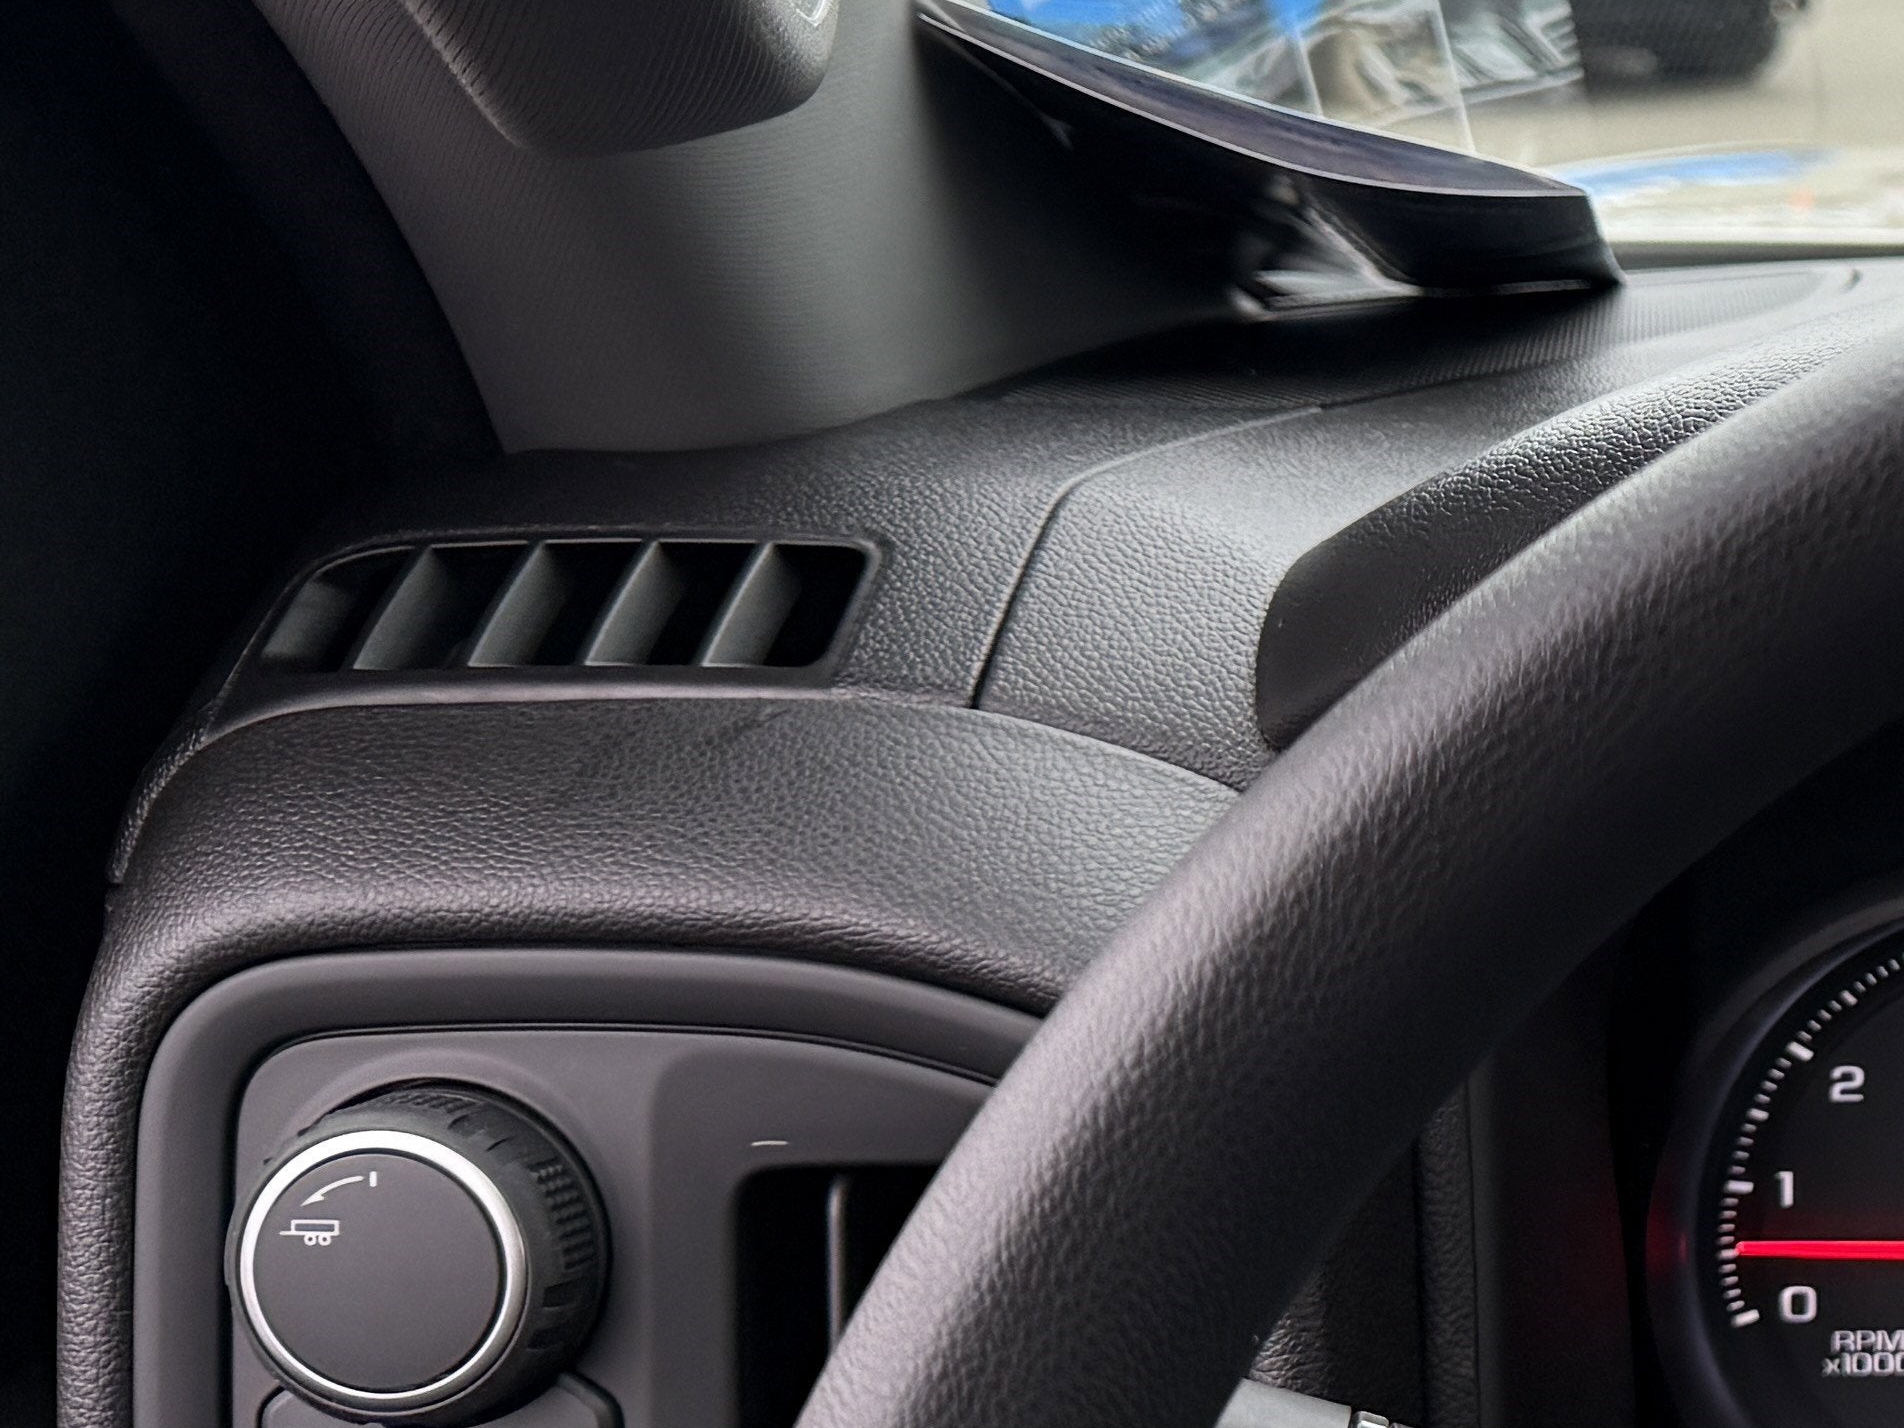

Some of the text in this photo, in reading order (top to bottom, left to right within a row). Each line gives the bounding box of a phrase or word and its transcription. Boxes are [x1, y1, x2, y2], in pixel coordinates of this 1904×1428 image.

[1830, 1066, 1864, 1101] 2
[1775, 1171, 1794, 1208] 1
[1779, 1285, 1816, 1322] 0
